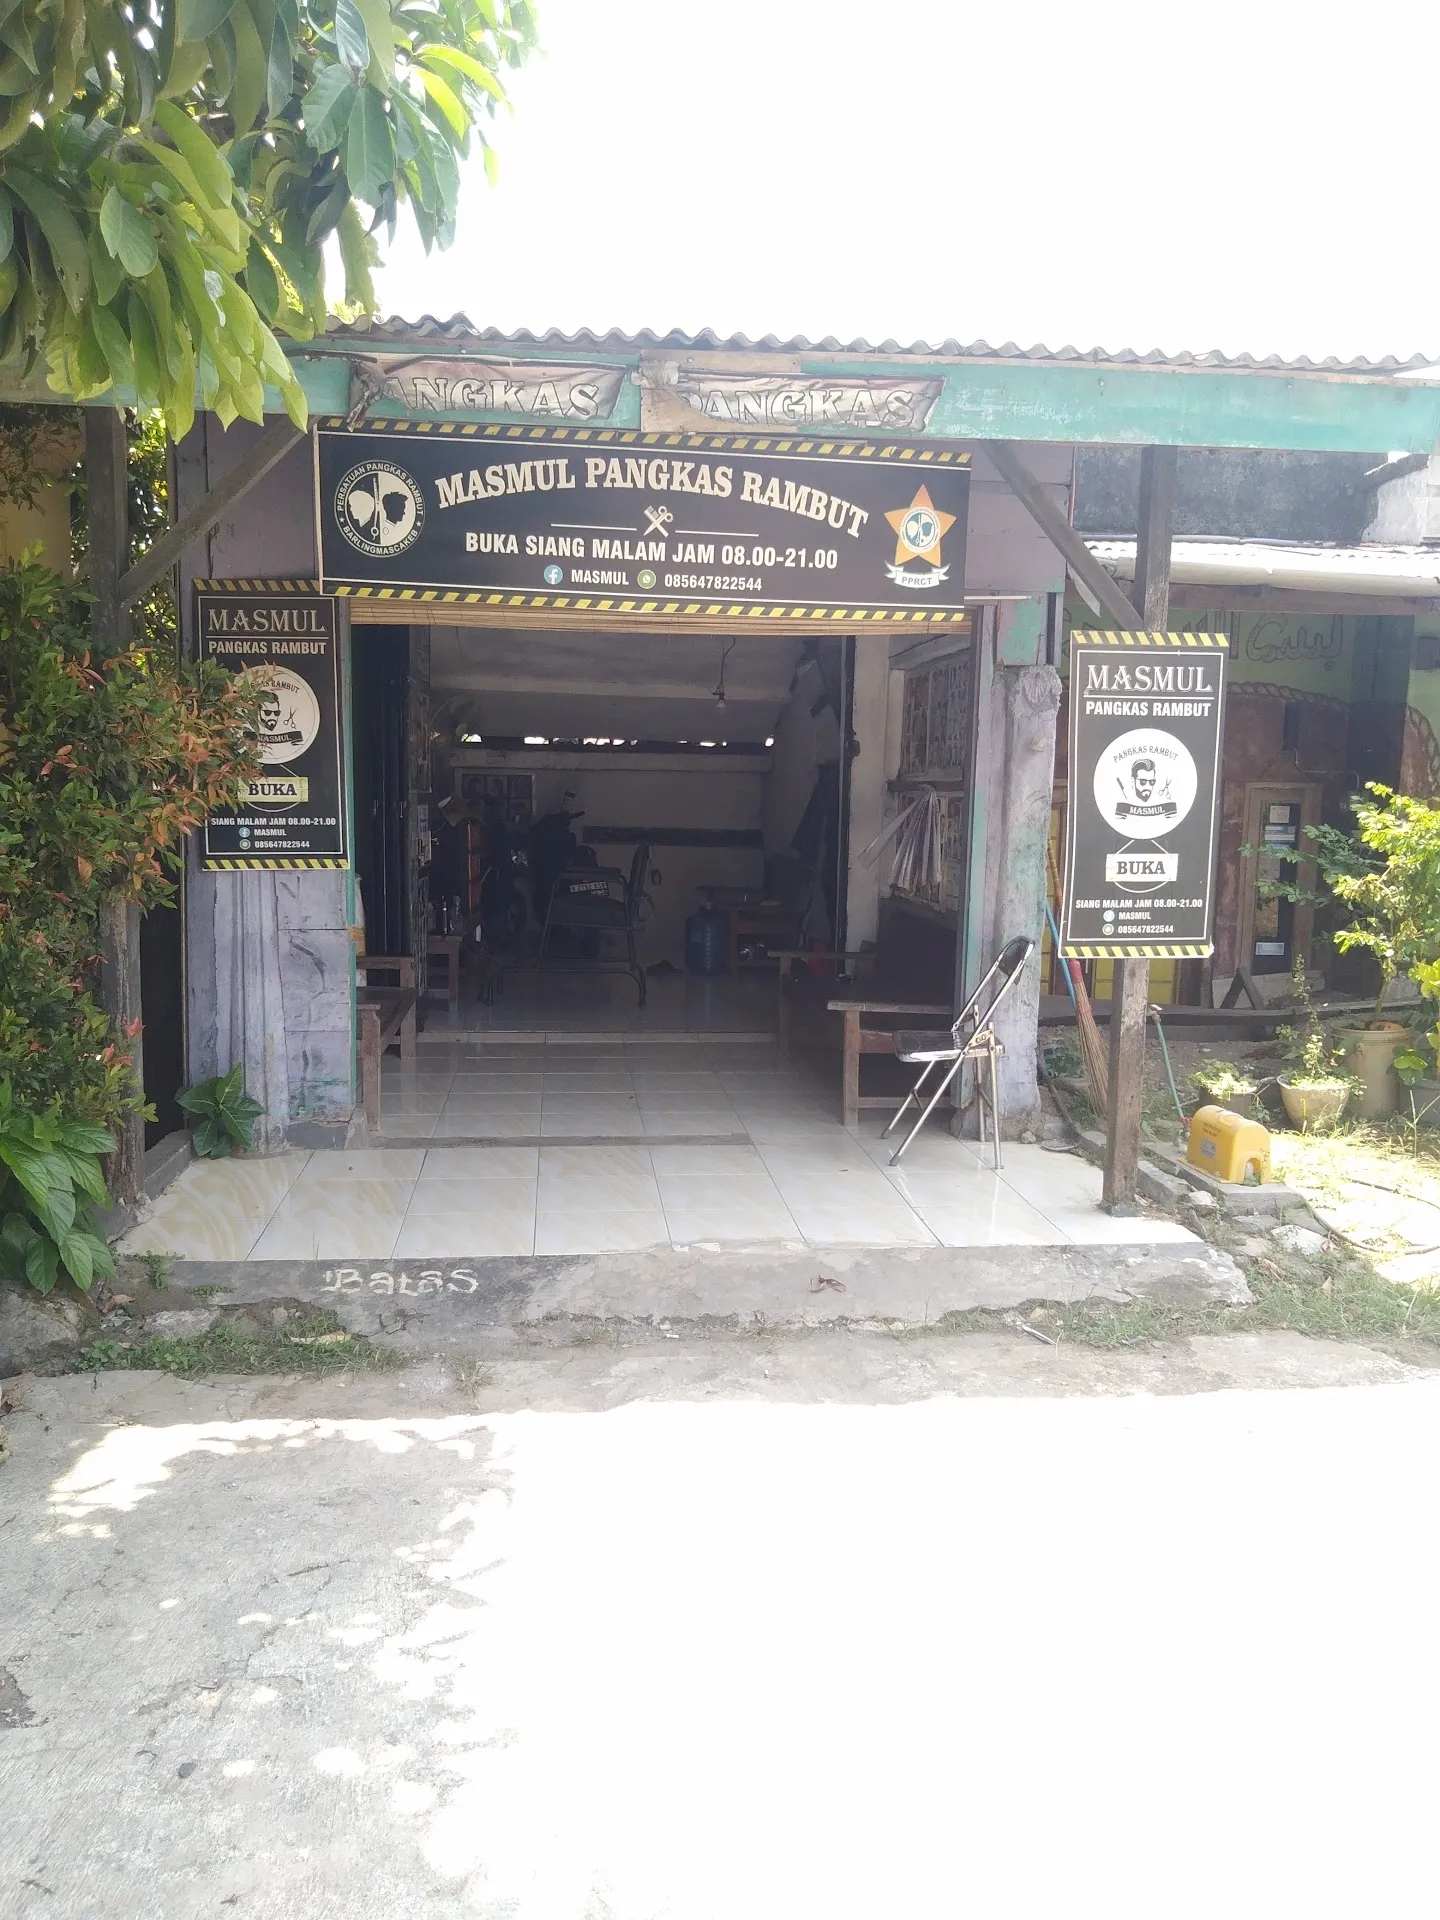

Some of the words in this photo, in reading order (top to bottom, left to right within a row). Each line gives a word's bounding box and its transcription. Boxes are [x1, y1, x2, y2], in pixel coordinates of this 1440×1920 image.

[337, 466, 366, 512] PERSATUAN
[366, 463, 407, 480] PANGKAS
[405, 479, 424, 516] RAMBUT
[435, 458, 576, 509] MASMUL
[585, 457, 733, 498] PANGKAS
[740, 471, 869, 539] RAMBUT
[343, 525, 418, 555] BARLINGMASCAKEB
[465, 532, 519, 554] BUKA
[525, 534, 585, 558] SIANG
[592, 540, 666, 562] MALAM
[672, 542, 715, 565] JAM
[721, 545, 838, 570] 08.00-21.00
[570, 569, 630, 586] MASMUL
[664, 573, 763, 591] 085647822544
[208, 609, 326, 633] MASMUL
[208, 641, 268, 655] PANGKAS
[271, 641, 327, 655] RAMBUT
[1086, 664, 1213, 693] MASMUL
[271, 680, 300, 694] RAMBUT
[1085, 701, 1149, 717] PANGKAS
[1152, 702, 1212, 718] RAMBUT
[1113, 745, 1147, 763] PANGKAS
[1149, 745, 1179, 760] RAMBUT
[248, 783, 298, 798] BUKA
[1128, 805, 1166, 815] MASMUL
[211, 817, 235, 826] SIANG
[237, 817, 267, 826] MALAM
[269, 817, 287, 826] JAM
[288, 817, 336, 826] 08.00-21.00
[254, 828, 287, 837] MASMUL
[254, 840, 311, 849] 085647822544
[1116, 861, 1166, 876] BUKA
[1075, 899, 1100, 909] SIANG
[1102, 899, 1133, 909] MALAM
[1134, 899, 1152, 908] JAM
[1153, 899, 1203, 908] 08.00-21.00
[1118, 911, 1152, 921] MASMUL
[1117, 925, 1174, 934] 085647822544
